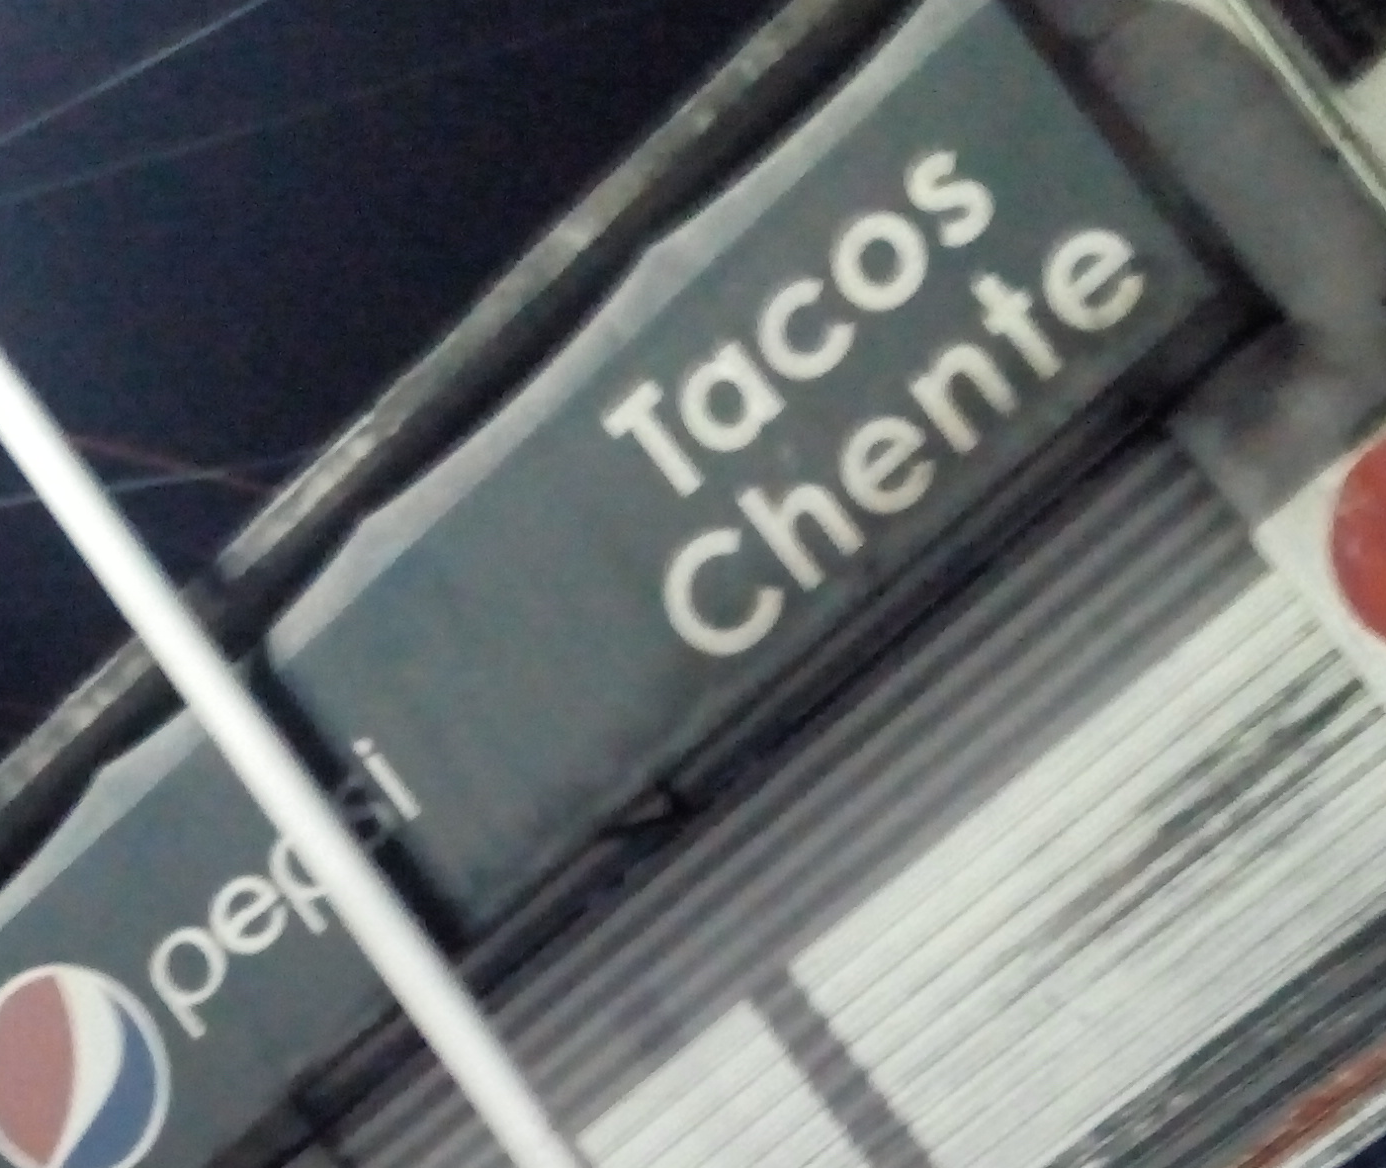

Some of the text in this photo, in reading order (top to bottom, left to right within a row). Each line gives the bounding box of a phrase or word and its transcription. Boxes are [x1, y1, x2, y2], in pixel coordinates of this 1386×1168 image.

[601, 149, 996, 498] Tacos
[662, 228, 1146, 658] Chente
[148, 735, 423, 1041] pepi
